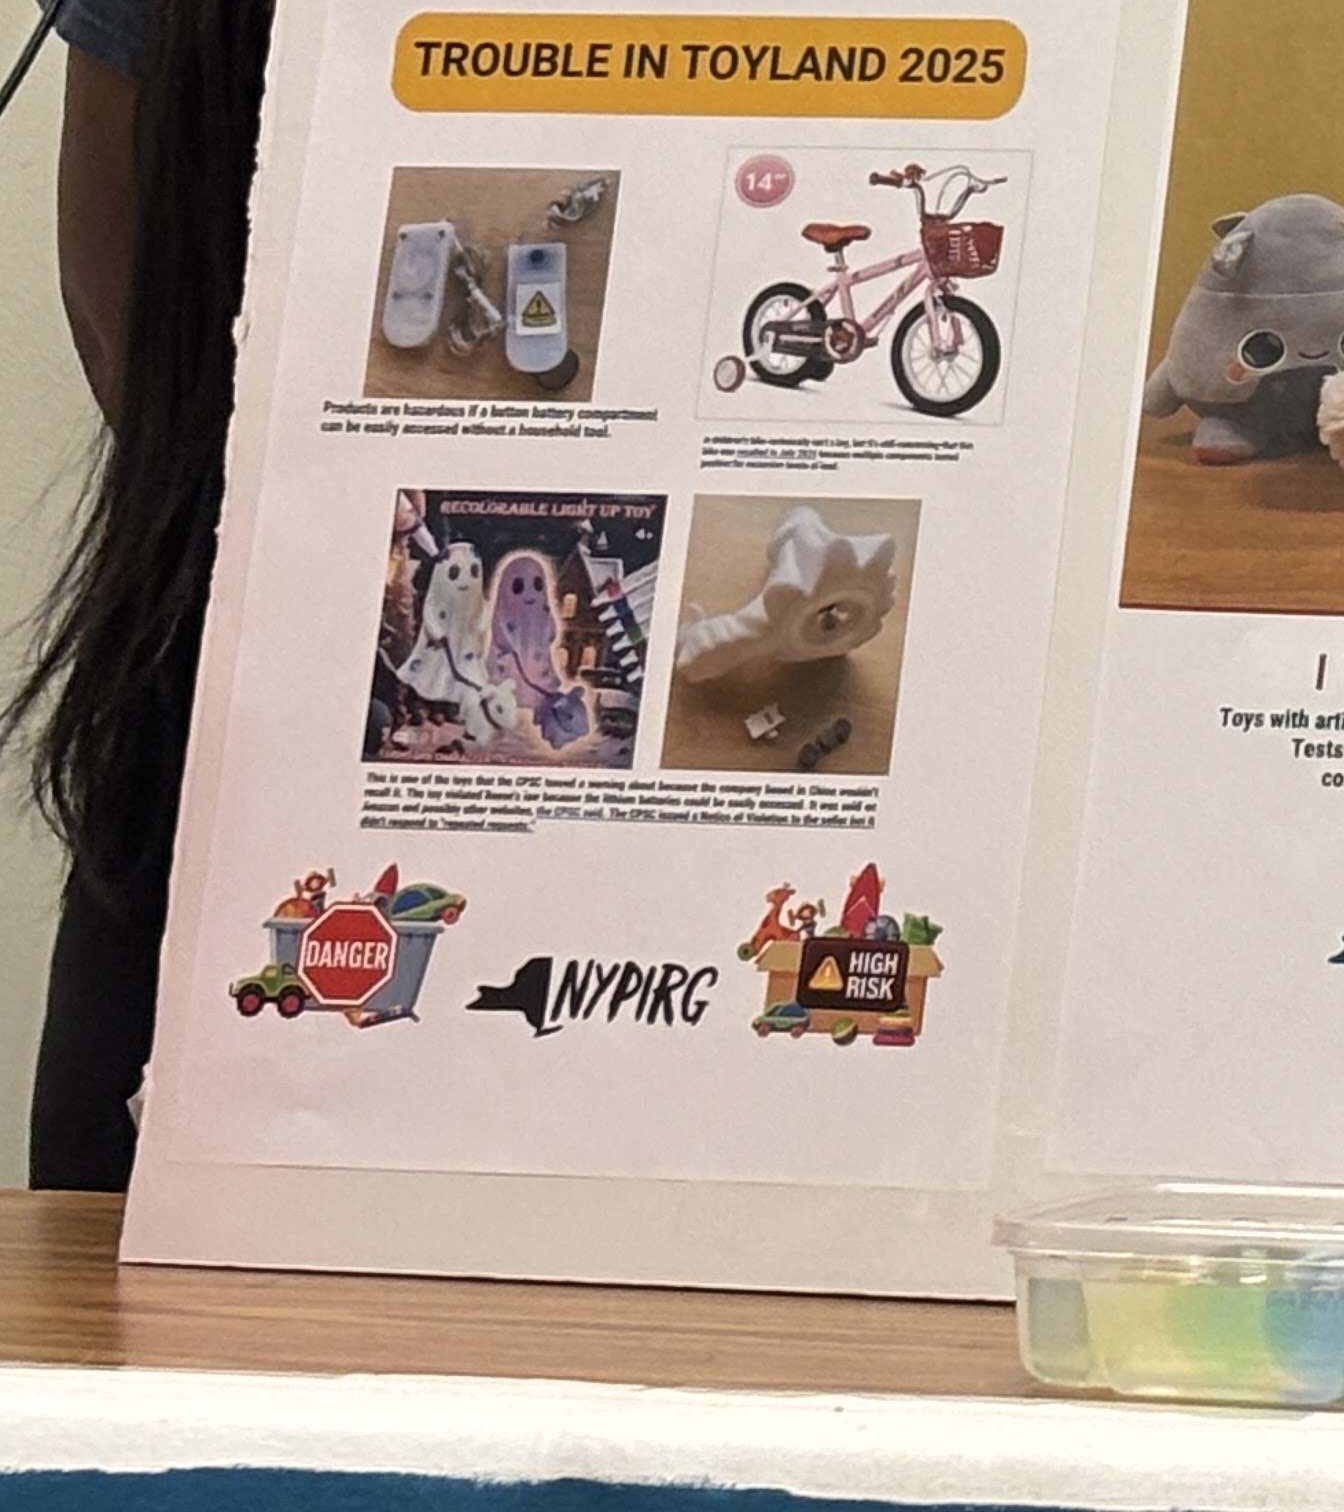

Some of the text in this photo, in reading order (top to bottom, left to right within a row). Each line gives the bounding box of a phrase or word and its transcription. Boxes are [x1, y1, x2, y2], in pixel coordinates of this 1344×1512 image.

[414, 40, 1005, 85] TROUBLE IN TOYLAND 2025
[440, 500, 657, 519] RECOLORABLE LIGHT UP TOY
[1219, 707, 1266, 733] Toys
[1270, 710, 1309, 731] with
[1291, 738, 1344, 761] Tests
[307, 940, 389, 971] DANGER
[848, 950, 898, 976] HIGH
[551, 957, 719, 1028] NYPIRG
[846, 974, 895, 1003] RISK
